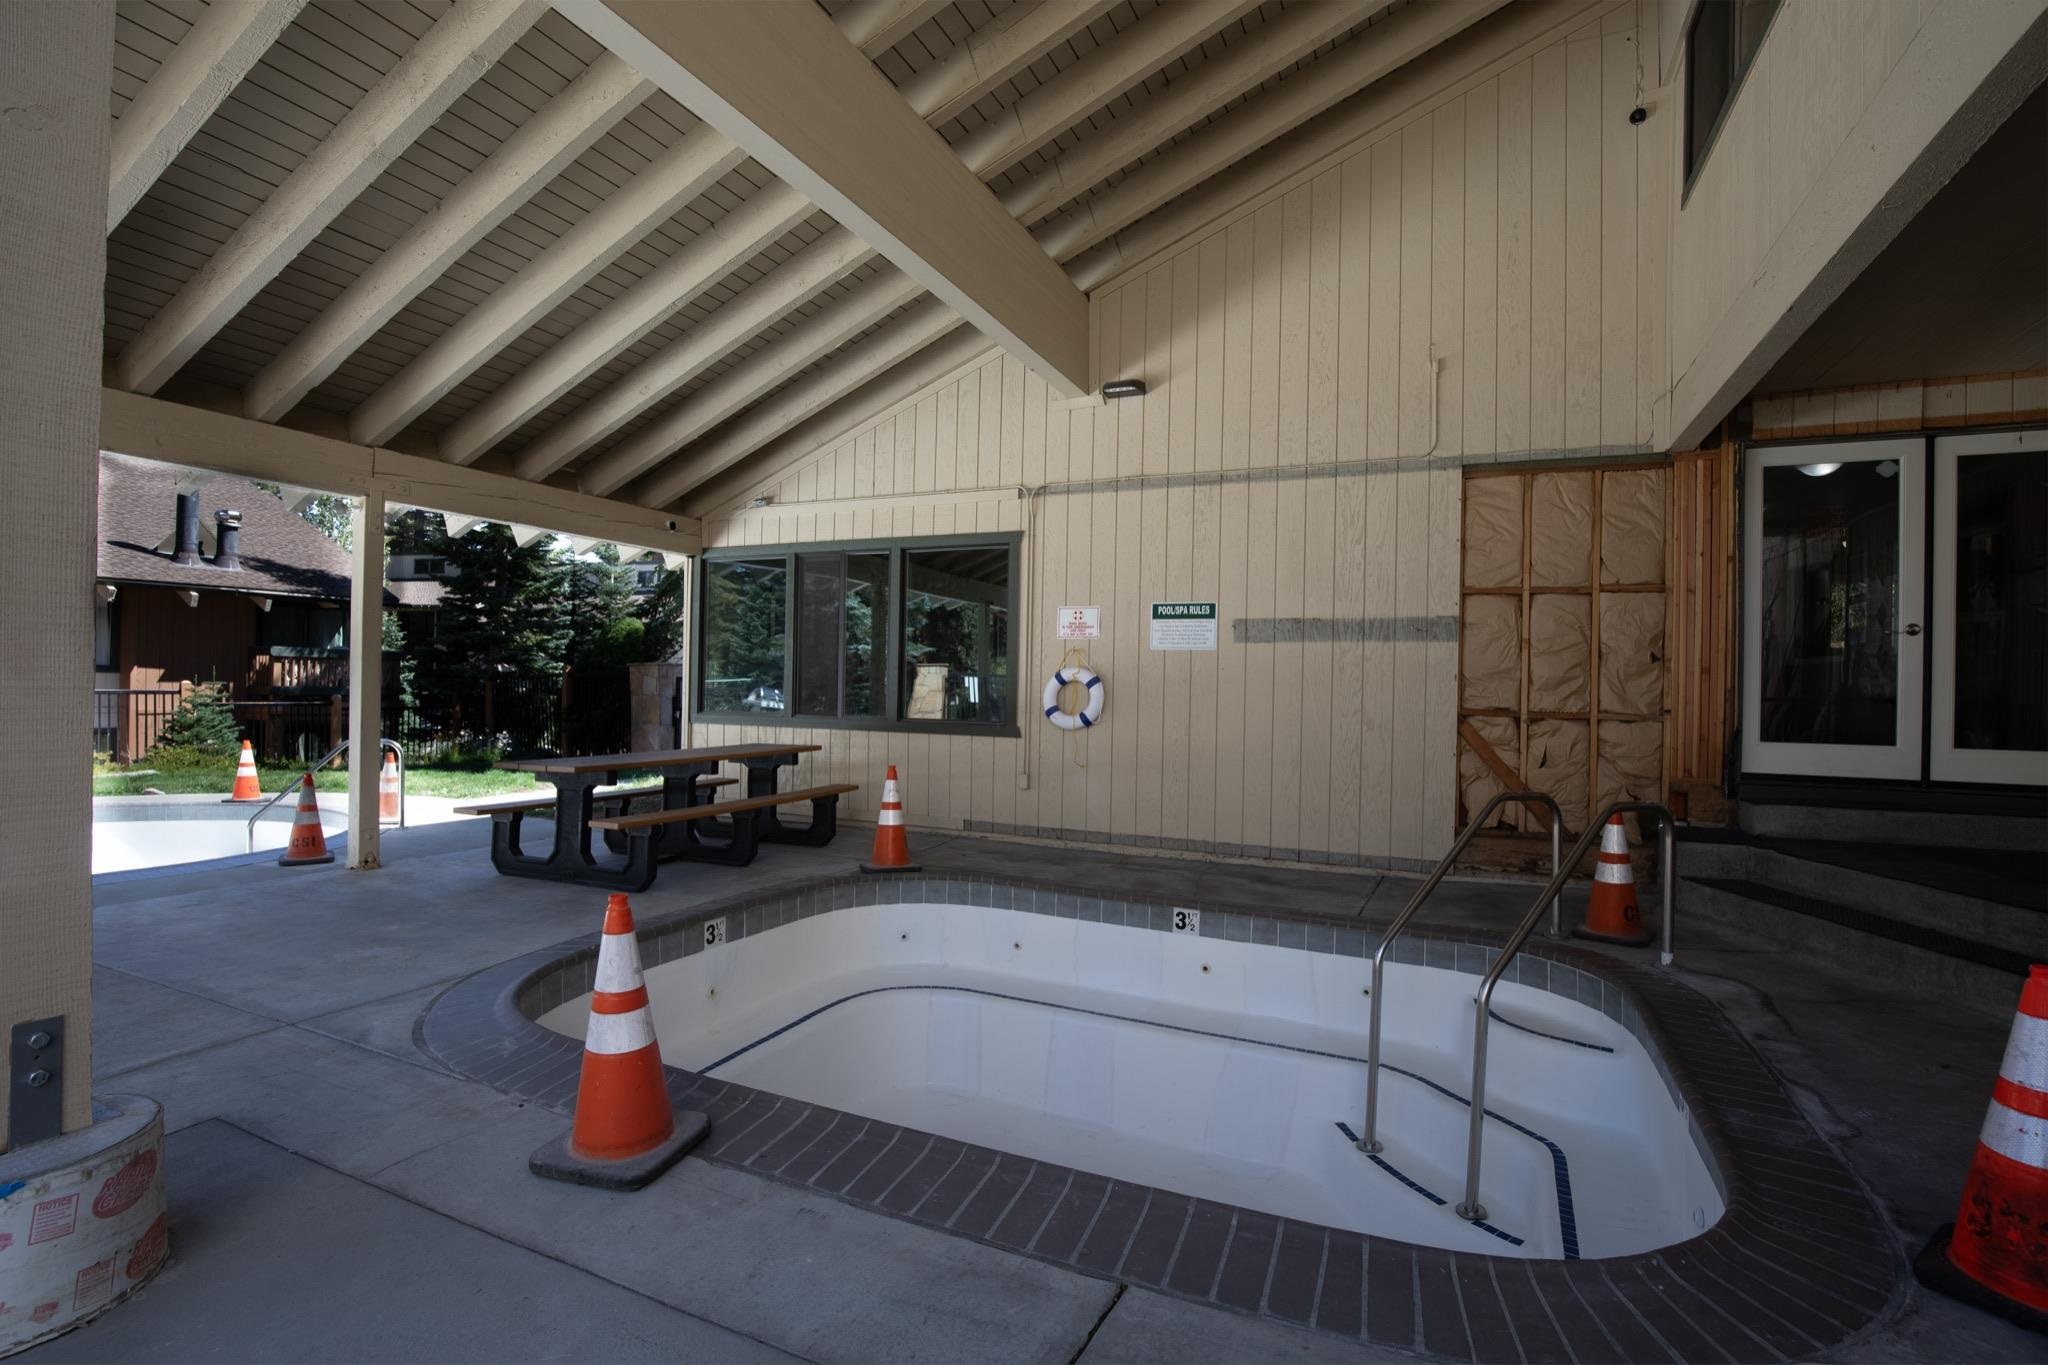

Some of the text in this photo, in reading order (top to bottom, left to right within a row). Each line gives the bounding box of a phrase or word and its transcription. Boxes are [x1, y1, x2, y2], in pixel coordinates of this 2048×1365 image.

[1158, 605, 1210, 615] POOL/SPA RULES
[38, 1197, 73, 1213] NOTICE
